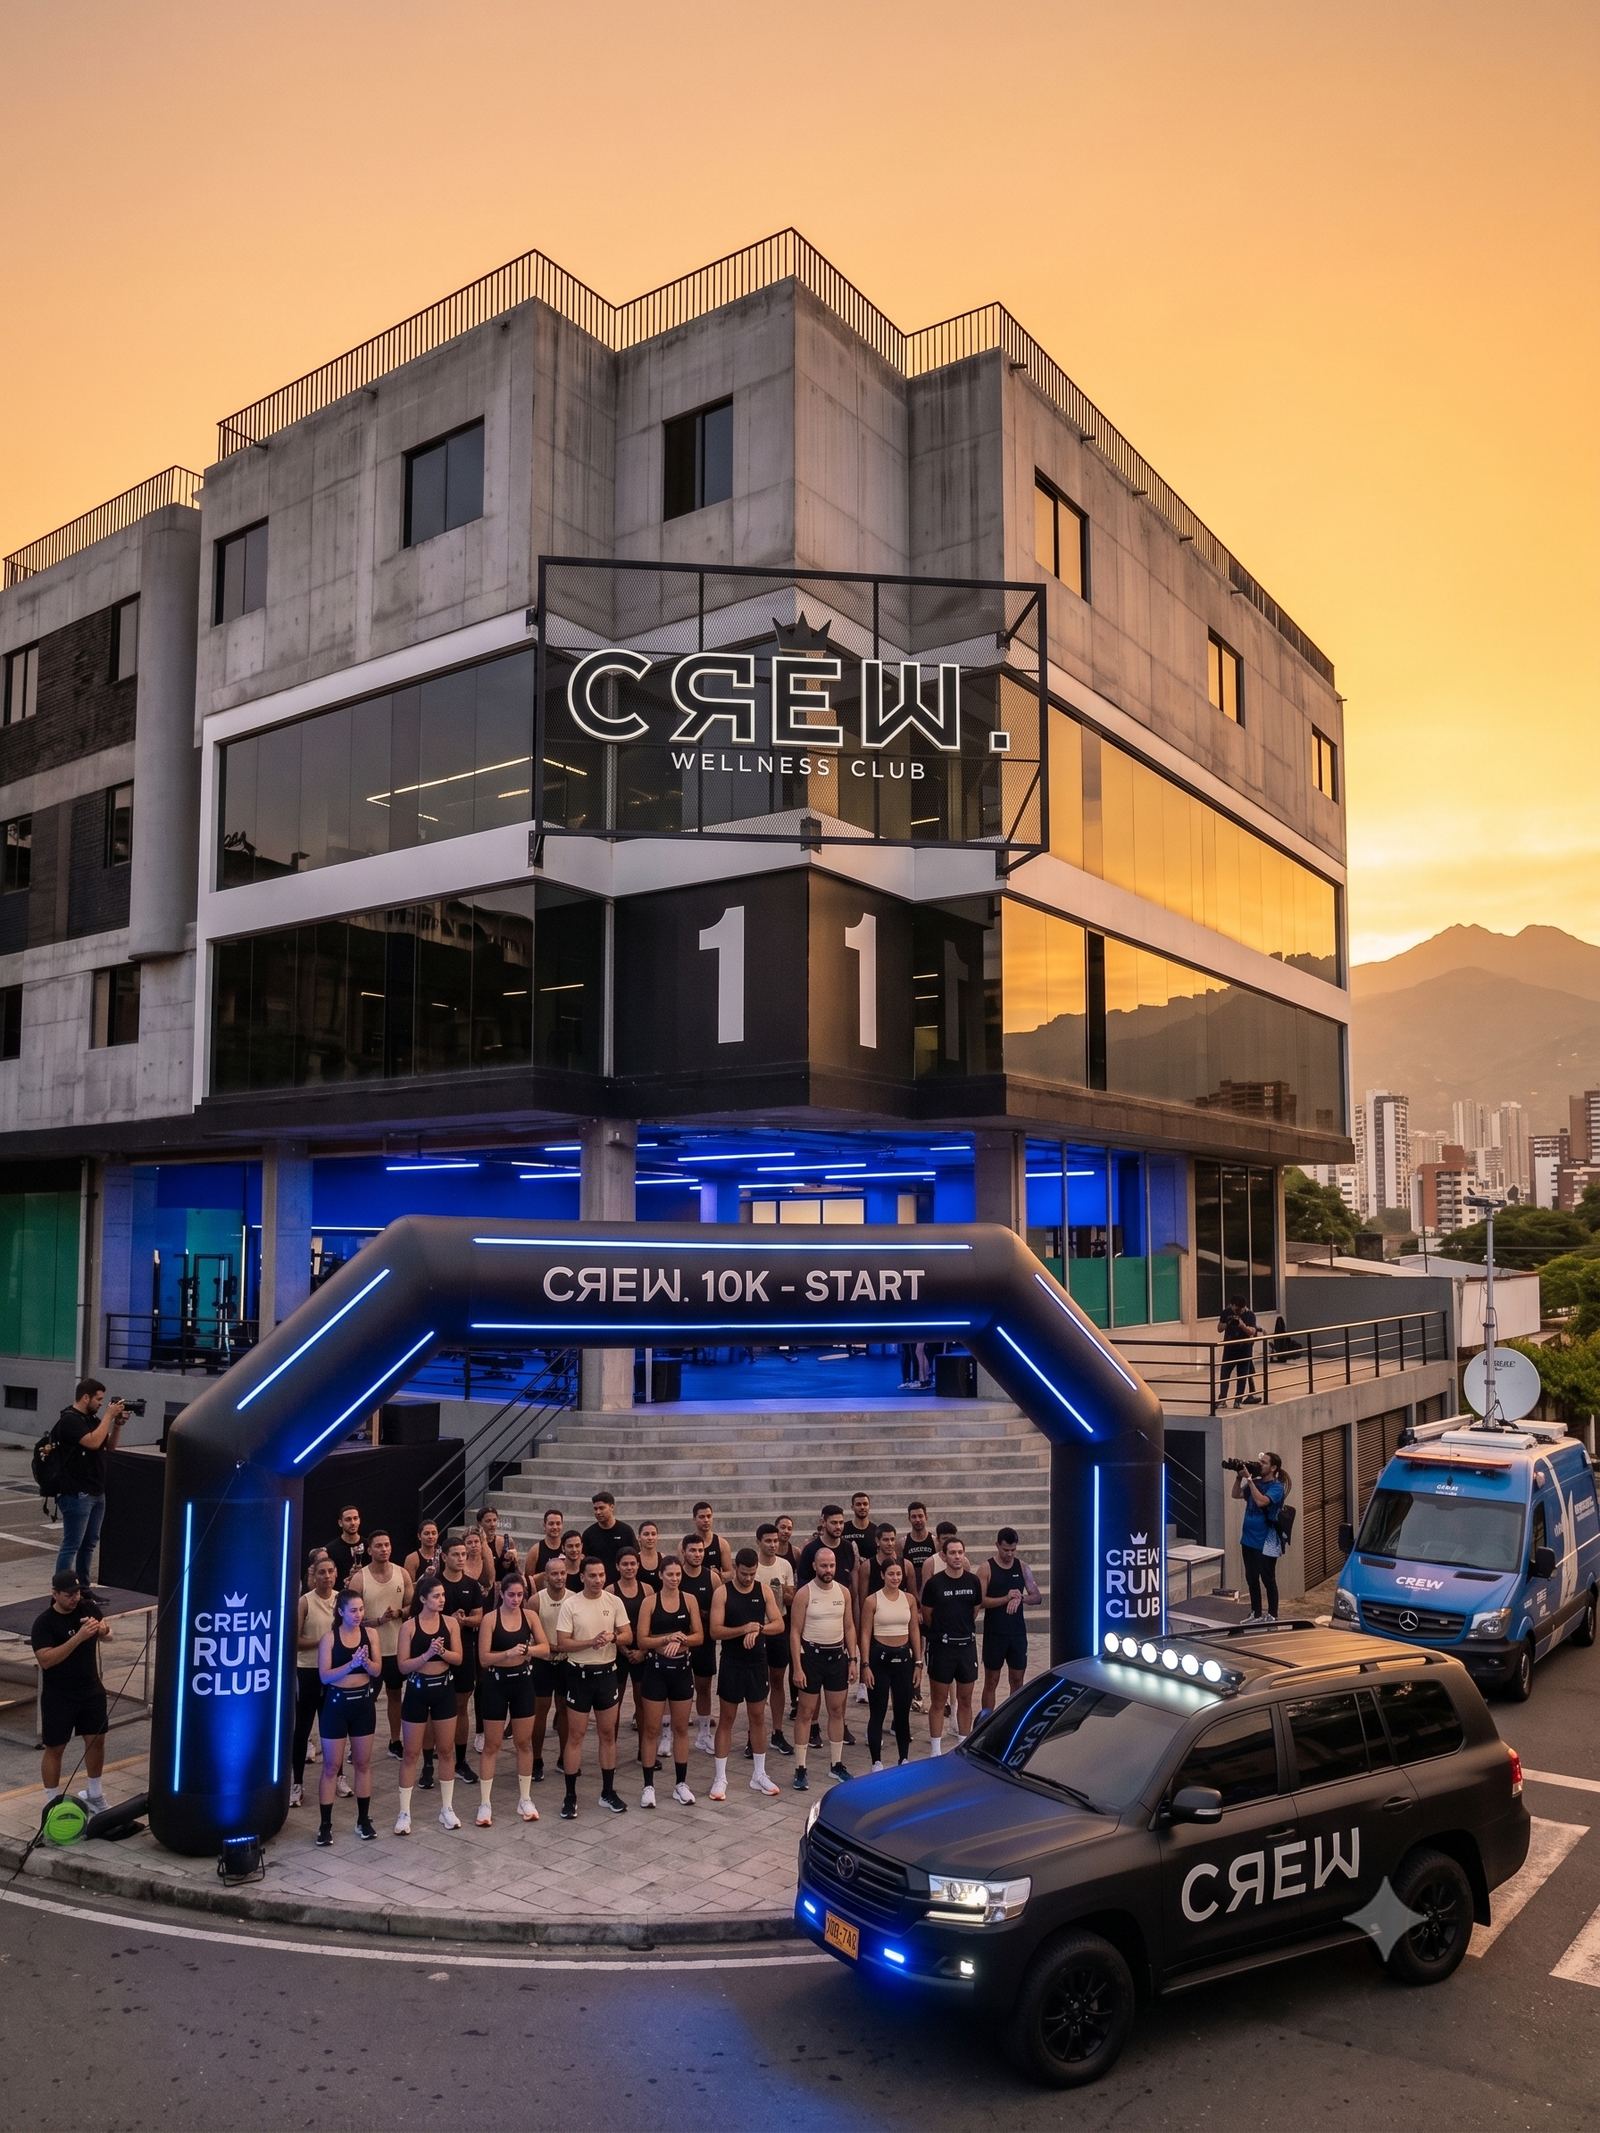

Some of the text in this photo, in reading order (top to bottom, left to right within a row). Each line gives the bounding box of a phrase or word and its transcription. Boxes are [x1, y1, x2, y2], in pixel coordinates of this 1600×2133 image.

[671, 751, 926, 780] WELLNESS CLUB
[701, 1269, 770, 1302] 10K
[804, 1269, 926, 1302] START
[1105, 1547, 1160, 1566] CREW
[1106, 1568, 1160, 1594] RUN
[1395, 1576, 1444, 1589] CREW
[1105, 1596, 1160, 1618] CLUB
[194, 1610, 272, 1632] CREW
[193, 1633, 271, 1667] RUN
[192, 1668, 271, 1696] CLUB
